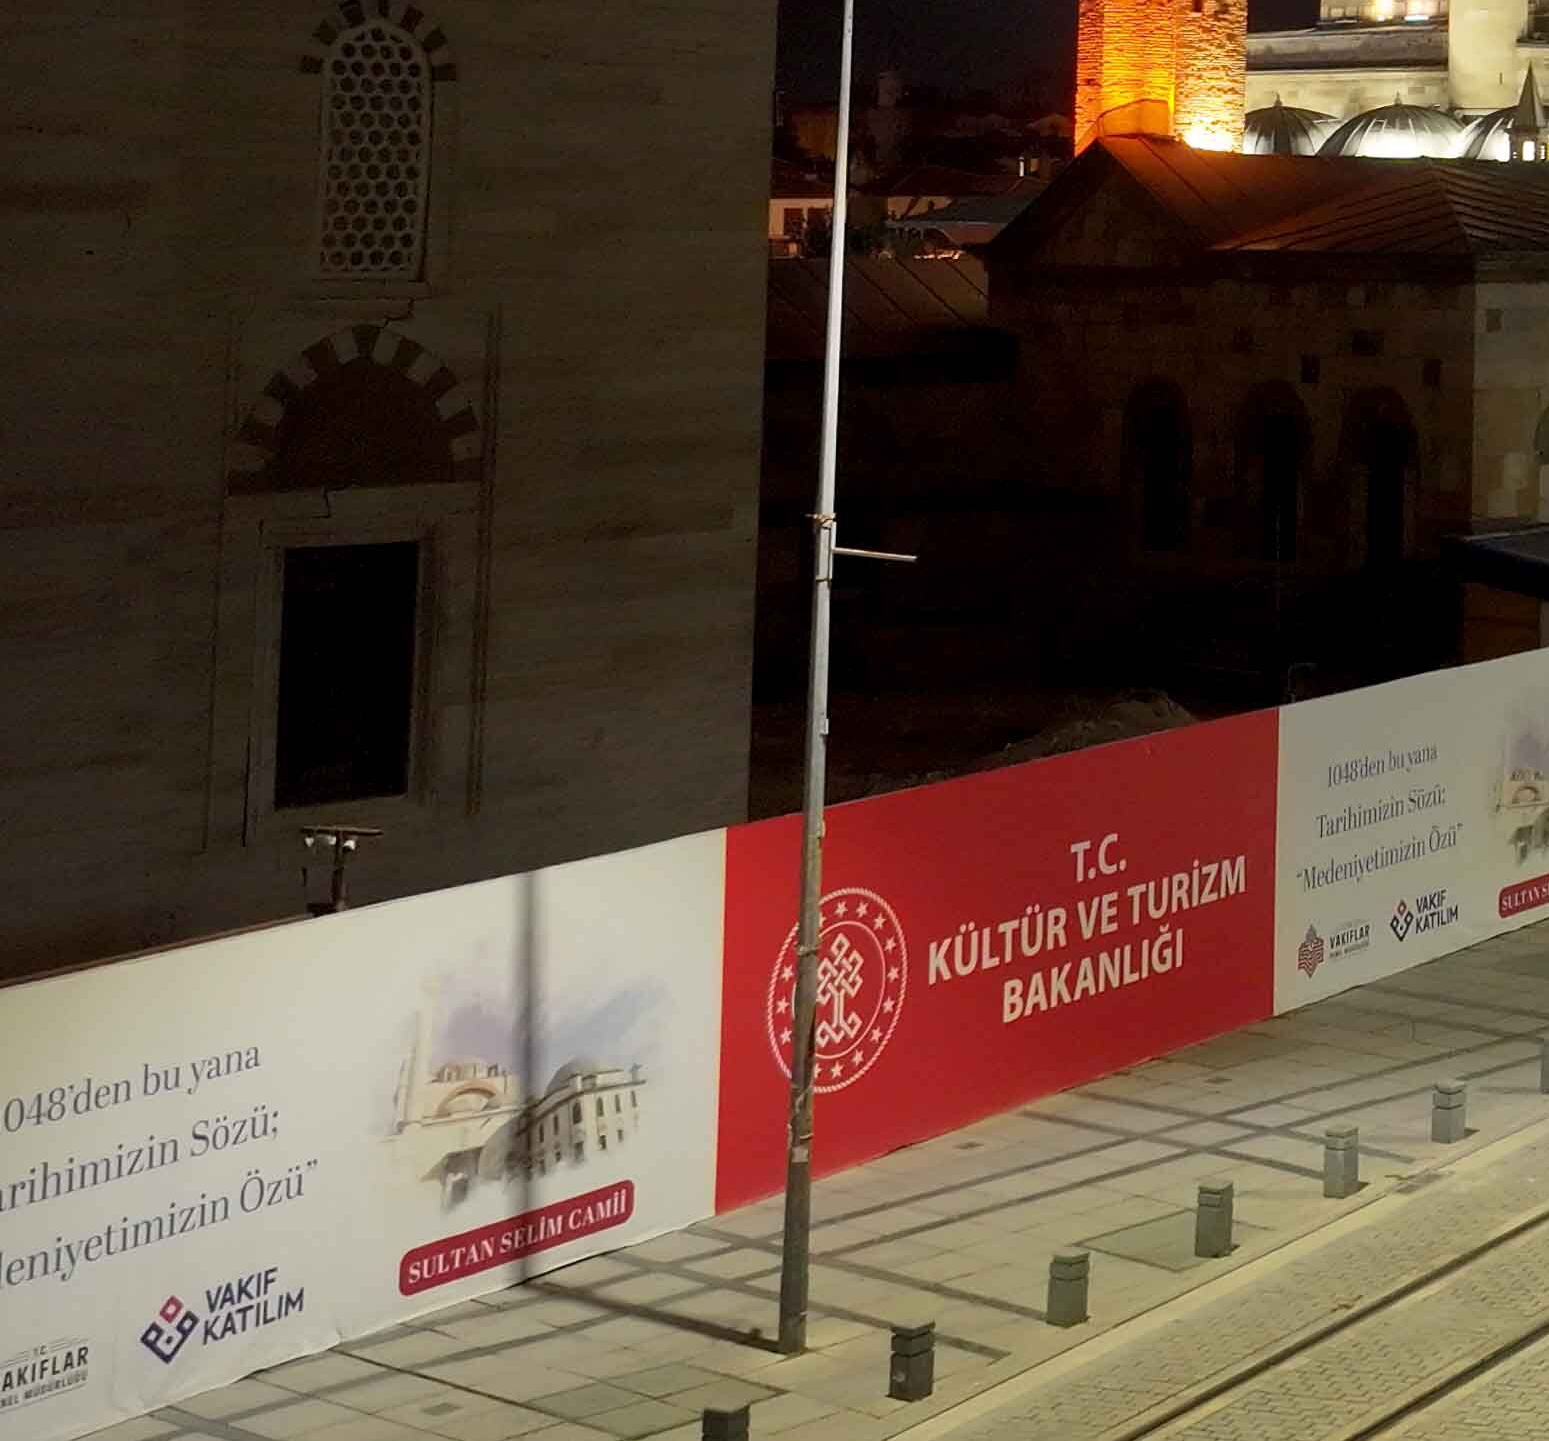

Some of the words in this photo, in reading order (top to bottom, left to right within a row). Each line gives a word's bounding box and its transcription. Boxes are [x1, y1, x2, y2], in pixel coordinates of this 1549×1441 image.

[1388, 749, 1405, 771] bu
[1406, 743, 1438, 773] yana
[1315, 796, 1404, 839] Tarihimizin
[1070, 832, 1127, 883] T.C.
[927, 905, 1067, 986] KÜLTÜR
[1077, 893, 1119, 941] VE
[1126, 855, 1248, 927] TURİZM
[1415, 889, 1447, 911] VAKIF
[1415, 905, 1458, 934] KATILIM
[1001, 923, 1184, 1024] BAKANLIĞI
[0, 1078, 132, 1134] 048'den
[143, 1063, 181, 1096] bu
[187, 1046, 260, 1095] yana
[0, 1134, 179, 1211] rihimizin
[190, 1104, 279, 1157] Sözü;
[0, 1192, 230, 1291] eniyetimizin
[239, 1158, 318, 1213] Özü"
[408, 1237, 497, 1284] SULTAN
[500, 1213, 563, 1253] SELİM
[568, 1189, 627, 1230] CAMİİ
[202, 1287, 304, 1345] KATILIM
[205, 1267, 278, 1313] VAKIF
[0, 1346, 89, 1392] AKIFLAR
